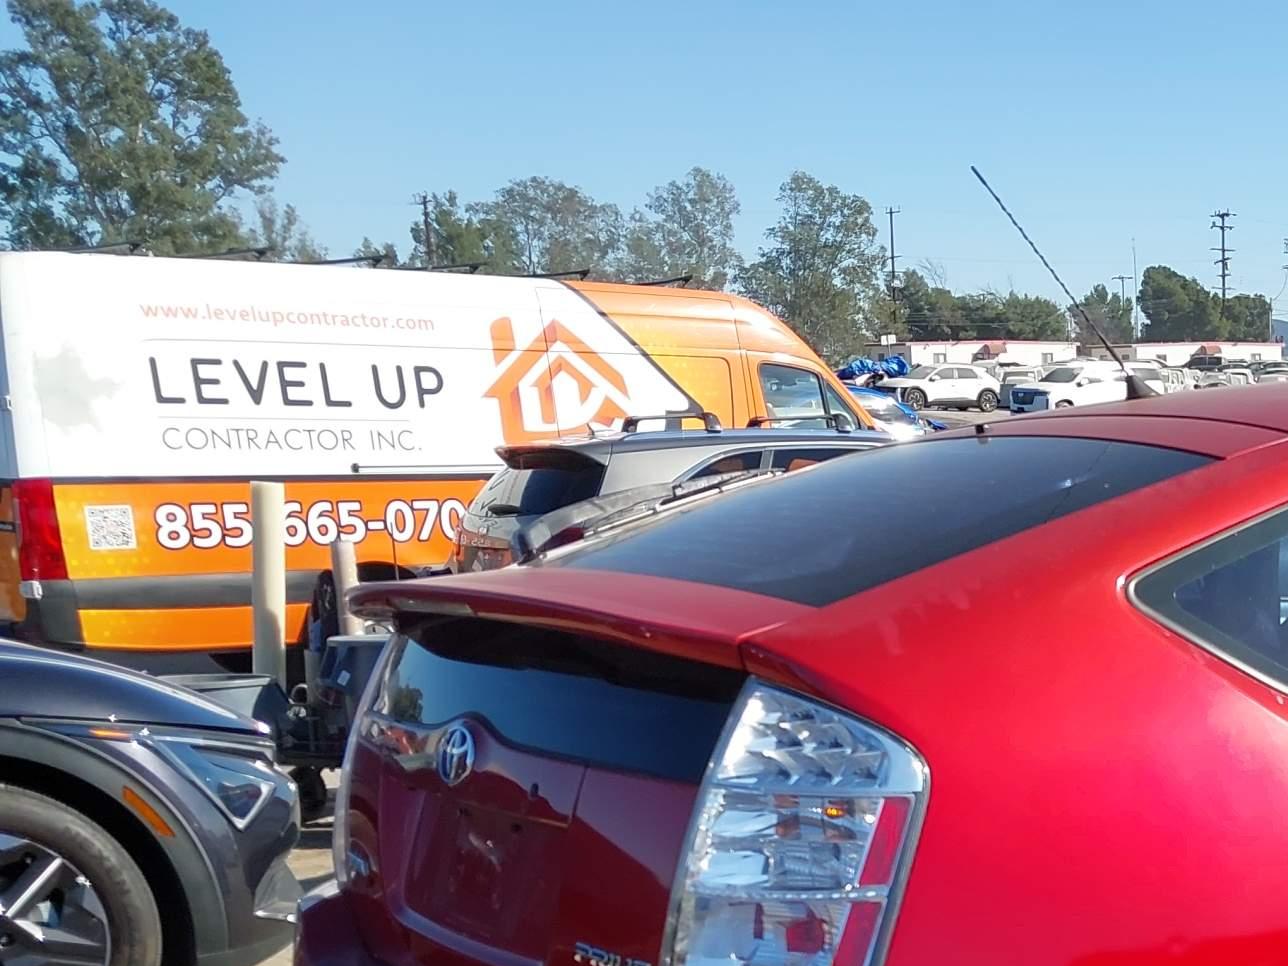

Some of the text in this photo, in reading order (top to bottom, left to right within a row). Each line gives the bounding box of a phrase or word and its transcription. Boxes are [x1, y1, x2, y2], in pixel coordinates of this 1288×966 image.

[140, 303, 435, 331] www.levelupcontractor.com
[149, 356, 444, 410] LEVEL UP
[162, 427, 422, 451] CONTRACTOR INC.
